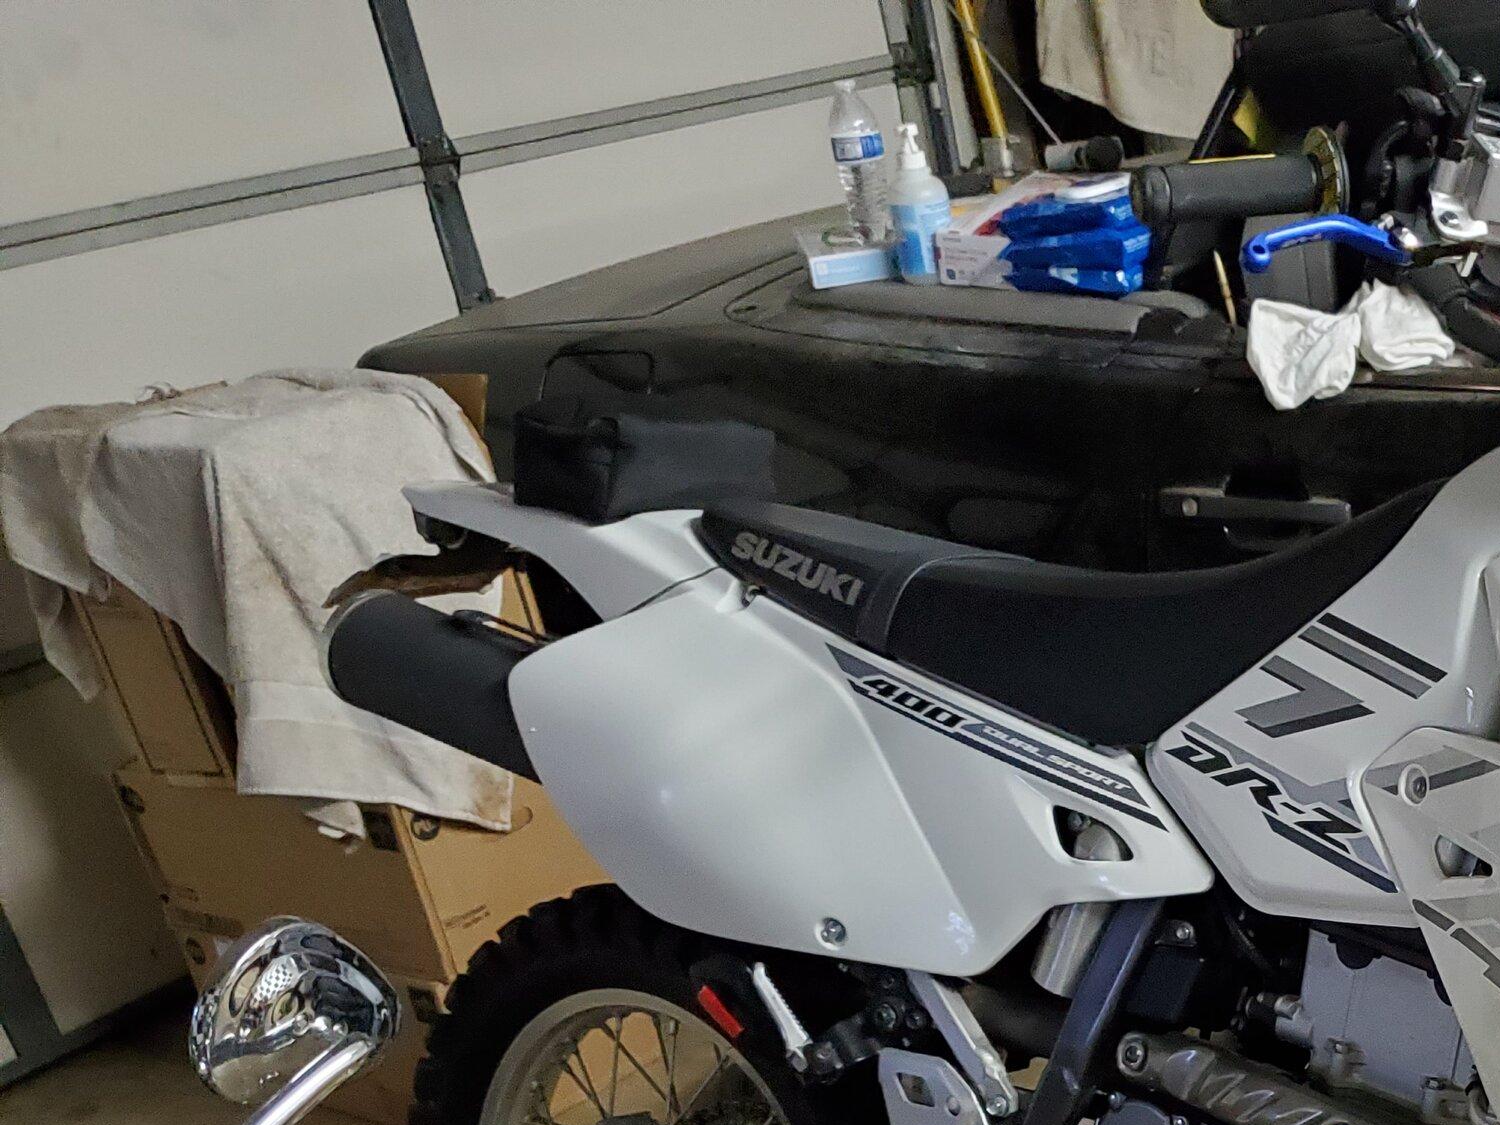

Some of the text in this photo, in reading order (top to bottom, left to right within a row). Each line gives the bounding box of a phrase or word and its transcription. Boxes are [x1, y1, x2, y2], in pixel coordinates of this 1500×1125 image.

[730, 531, 863, 607] SUZUKI
[862, 678, 1133, 791] 400 DUAL SPORT
[1163, 730, 1366, 856] DR-Z
